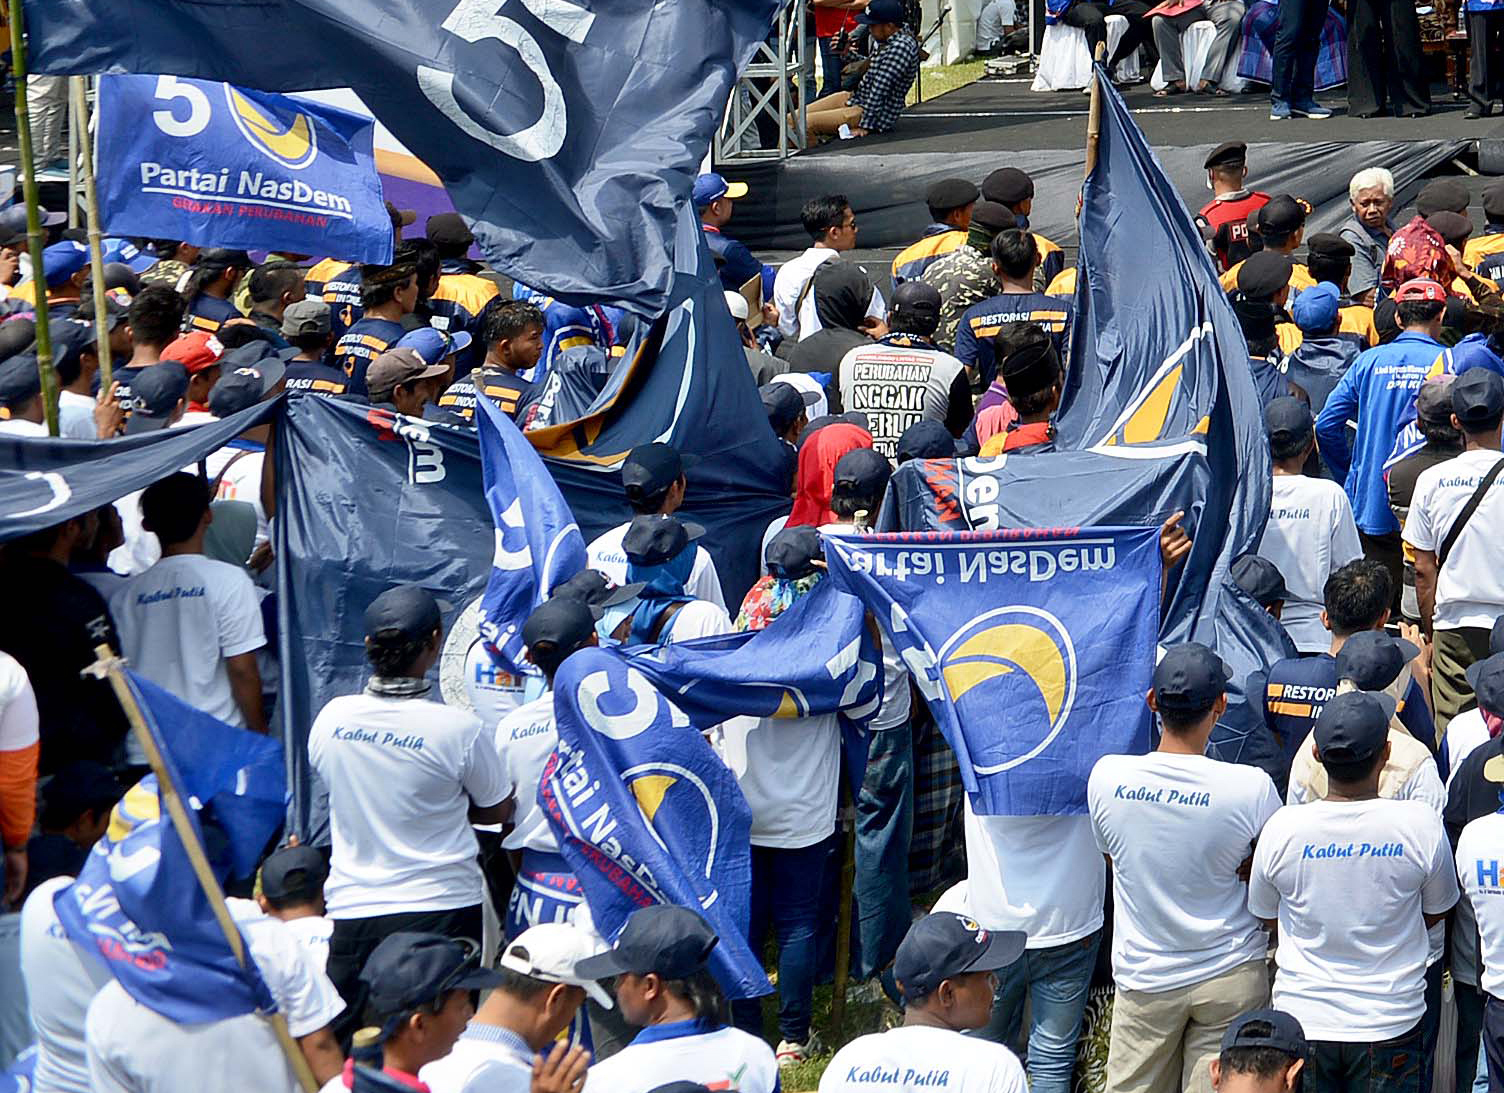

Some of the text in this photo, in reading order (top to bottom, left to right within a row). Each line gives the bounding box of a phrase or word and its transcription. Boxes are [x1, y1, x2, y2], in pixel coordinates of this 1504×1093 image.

[153, 75, 211, 137] 5
[140, 162, 351, 212] Partai NasDem
[981, 312, 1029, 325] RESTORASI
[854, 364, 931, 382] PERUBAHAN
[854, 386, 925, 410] NGGAK
[1438, 478, 1475, 488] Kabut
[596, 551, 629, 564] Kabu
[1284, 683, 1336, 701] RESTOR
[332, 726, 424, 751] Kabut Putih
[510, 723, 551, 741] Kabut
[1114, 784, 1210, 808] Kabut Putih
[1303, 843, 1404, 860] Kabut Putih
[846, 1064, 949, 1088] Kabut Putih
